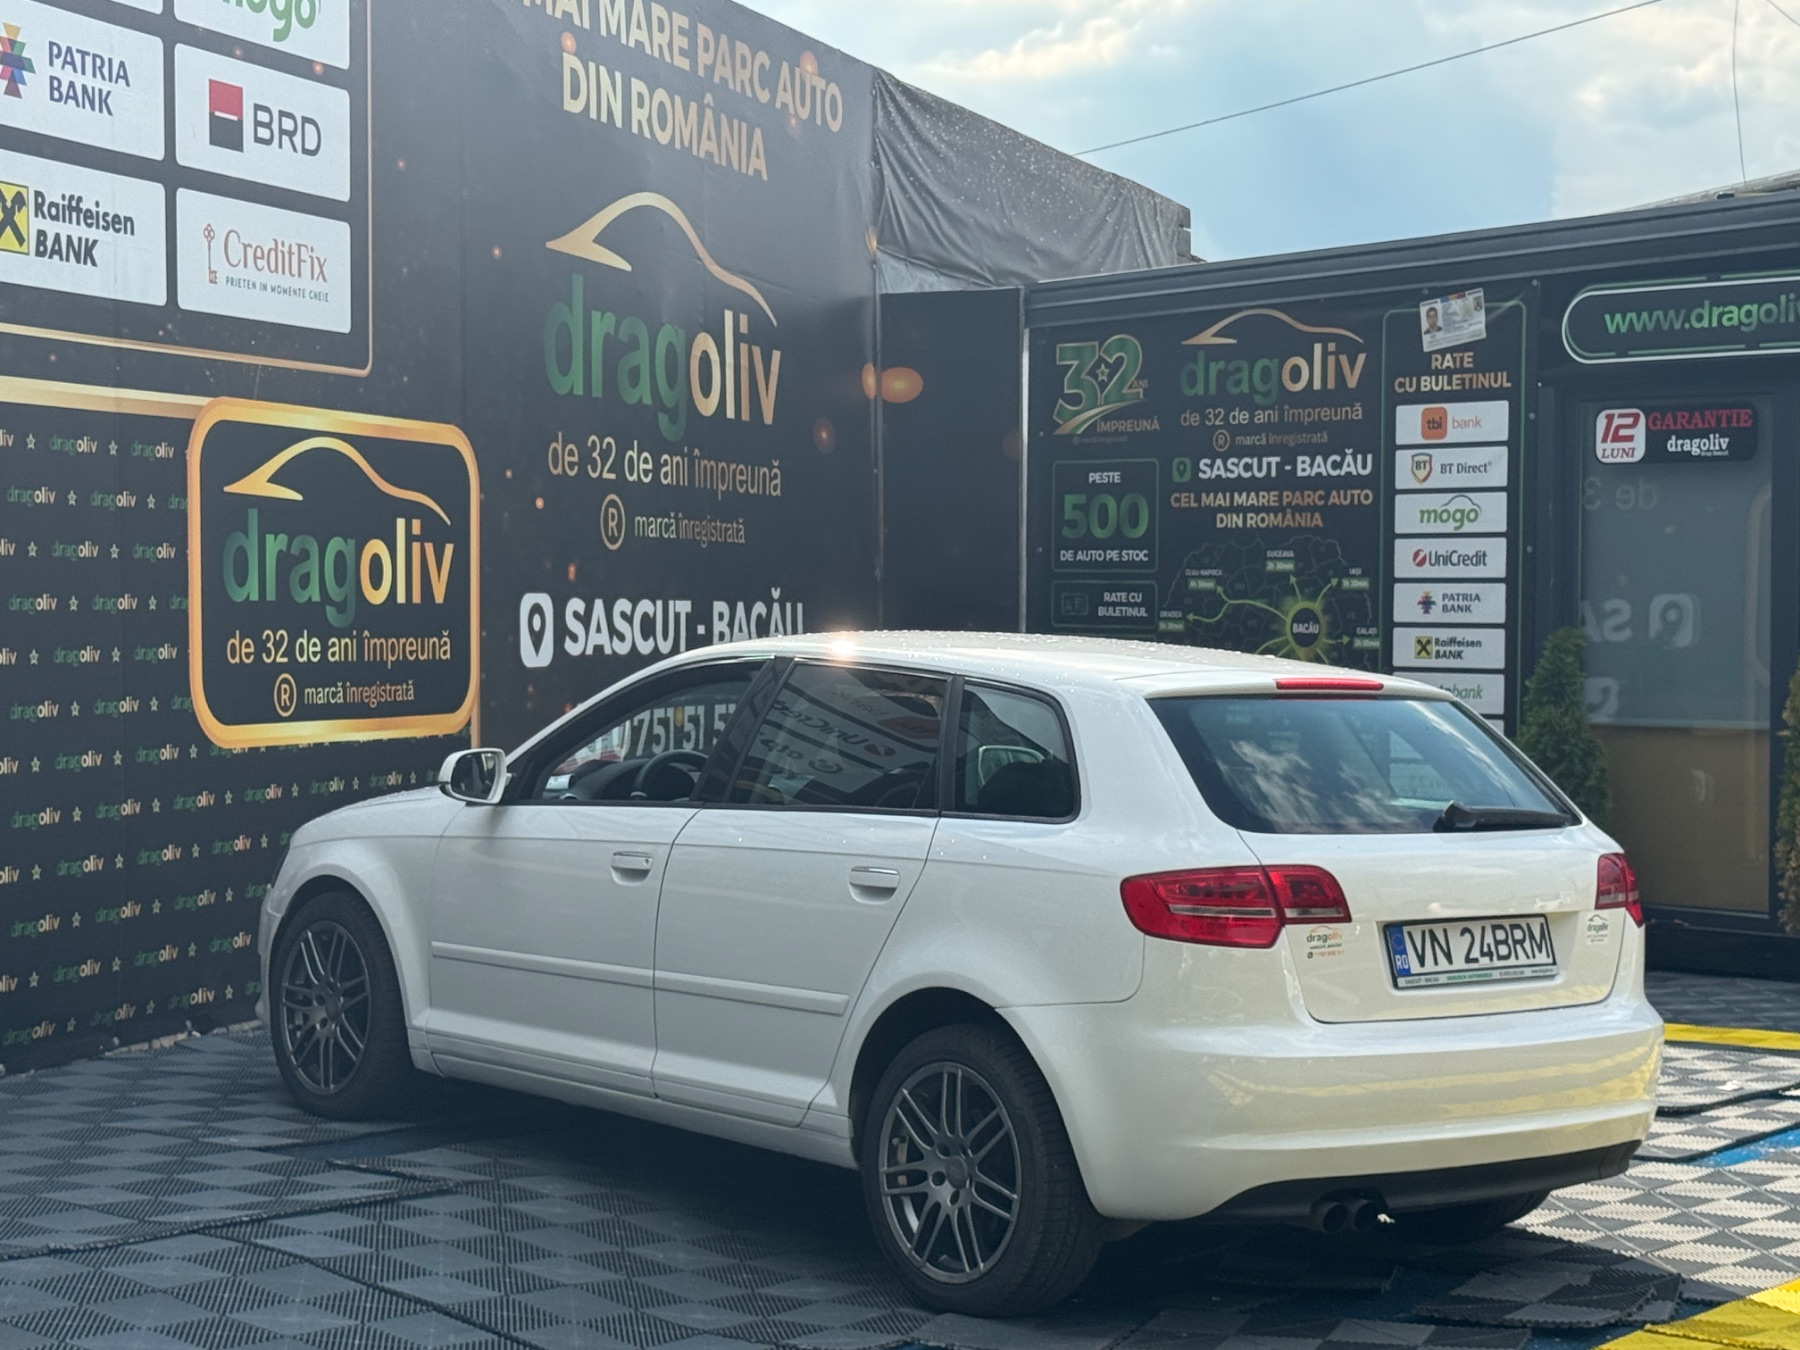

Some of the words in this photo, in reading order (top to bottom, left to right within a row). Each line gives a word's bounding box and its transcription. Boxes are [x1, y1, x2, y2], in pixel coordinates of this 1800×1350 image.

[222, 0, 316, 42] go
[47, 40, 130, 87] PATRIA
[523, 0, 590, 30] AI
[600, 0, 691, 70] MARE
[698, 23, 771, 103] PARC
[775, 61, 842, 133] AUTO
[49, 75, 113, 117] BANK
[562, 52, 623, 129] DIN
[631, 77, 768, 181] ROMÂNIA
[253, 103, 322, 157] BRD
[34, 190, 135, 236] Raiffeisen
[35, 229, 98, 267] BANK
[224, 229, 327, 283] CreditFix
[226, 275, 257, 290] PRIETEN
[260, 282, 268, 292] IN
[270, 285, 306, 299] MOMENTE
[309, 290, 329, 302] CHEIE
[1604, 293, 1800, 334] www.dragoli
[544, 274, 782, 442] dragoliv
[1431, 352, 1474, 370] RATE
[1053, 333, 1142, 425] 32
[1180, 343, 1366, 405] dragoliv
[1394, 376, 1417, 393] CU
[1420, 372, 1512, 392] BULETINUL
[1180, 409, 1200, 426] de
[1204, 408, 1225, 426] 32
[1229, 407, 1250, 425] de
[1254, 408, 1279, 424] ani
[1284, 402, 1363, 425] împreună
[1426, 416, 1442, 431] tbi
[1452, 416, 1482, 429] bank
[1648, 408, 1753, 430] GARANTIE
[1235, 433, 1266, 446] marcă
[1268, 431, 1328, 446] înregistrată
[1601, 412, 1640, 444] 12
[51, 434, 98, 456] dragoliv
[131, 440, 174, 460] dragoliv
[1601, 447, 1636, 459] LUNI
[1667, 433, 1729, 456] dragoliv
[548, 431, 579, 477] de
[587, 434, 617, 480] 32
[625, 440, 653, 484] de
[660, 448, 688, 488] ani
[694, 449, 782, 500] împreună
[1198, 456, 1280, 479] SASCUT
[1296, 448, 1373, 477] BACĂU
[1415, 460, 1428, 471] BT
[1440, 463, 1453, 475] BT
[1088, 472, 1121, 485] PESTE
[7, 485, 56, 507] dragoliv
[91, 490, 137, 511] dragoliv
[1170, 493, 1198, 508] CEL
[1201, 492, 1230, 507] MAI
[1233, 491, 1279, 506] MARE
[1283, 490, 1325, 506] PARC
[1328, 489, 1373, 505] AUTO
[1061, 492, 1149, 539] 500
[1216, 513, 1243, 529] DIN
[1247, 509, 1323, 528] ROMÂNIA
[1419, 507, 1479, 531] mogo
[634, 511, 676, 538] marcă
[678, 514, 746, 548] înregistrată
[51, 540, 99, 562] dragoliv
[133, 542, 176, 562] dragoliv
[1060, 550, 1074, 562] DE
[1076, 550, 1105, 562] AUTO
[1106, 550, 1120, 562] PE
[1121, 550, 1149, 562] STOC
[1429, 550, 1487, 567] UniCredit
[223, 508, 454, 628] dragoliv
[8, 593, 57, 615] dragoliv
[92, 593, 138, 614] dragoliv
[1104, 592, 1126, 603] RATE
[1128, 592, 1143, 603] CU
[1442, 593, 1481, 603] PATRIA
[1442, 604, 1472, 614] BANK
[1098, 606, 1148, 617] BULETINUL
[564, 597, 692, 657] SASCUT
[53, 645, 100, 667] dragoliv
[134, 643, 177, 664] dragoliv
[227, 631, 254, 664] de
[262, 630, 289, 664] 32
[295, 631, 321, 663] de
[328, 631, 357, 662] ani
[363, 630, 451, 669] împreună
[1434, 637, 1482, 648] Raiffeisen
[1434, 650, 1464, 660] BANK
[304, 680, 344, 706] marcă
[345, 679, 414, 708] înregistrată
[10, 700, 59, 722] dragoliv
[94, 696, 139, 717] dragoliv
[55, 750, 102, 772] dragoliv
[135, 743, 179, 764] dragoliv
[11, 807, 61, 830] dragoliv
[95, 798, 141, 820] dragoliv
[173, 790, 215, 811] dragoliv
[244, 784, 283, 803] dragoliv
[310, 776, 345, 797] dragoliv
[369, 771, 403, 789] dragoliv
[56, 854, 104, 877] dragoliv
[137, 844, 182, 866] dragoliv
[212, 835, 251, 856] dragoliv
[11, 914, 60, 938] dragoliv
[95, 901, 141, 924] dragoliv
[174, 889, 216, 911] dragoliv
[53, 959, 101, 983] dragoliv
[134, 944, 179, 967] dragoliv
[209, 932, 252, 954] dragoliv
[1407, 928, 1453, 968] VN
[1459, 922, 1551, 964] 24BRM
[1395, 954, 1409, 970] RO
